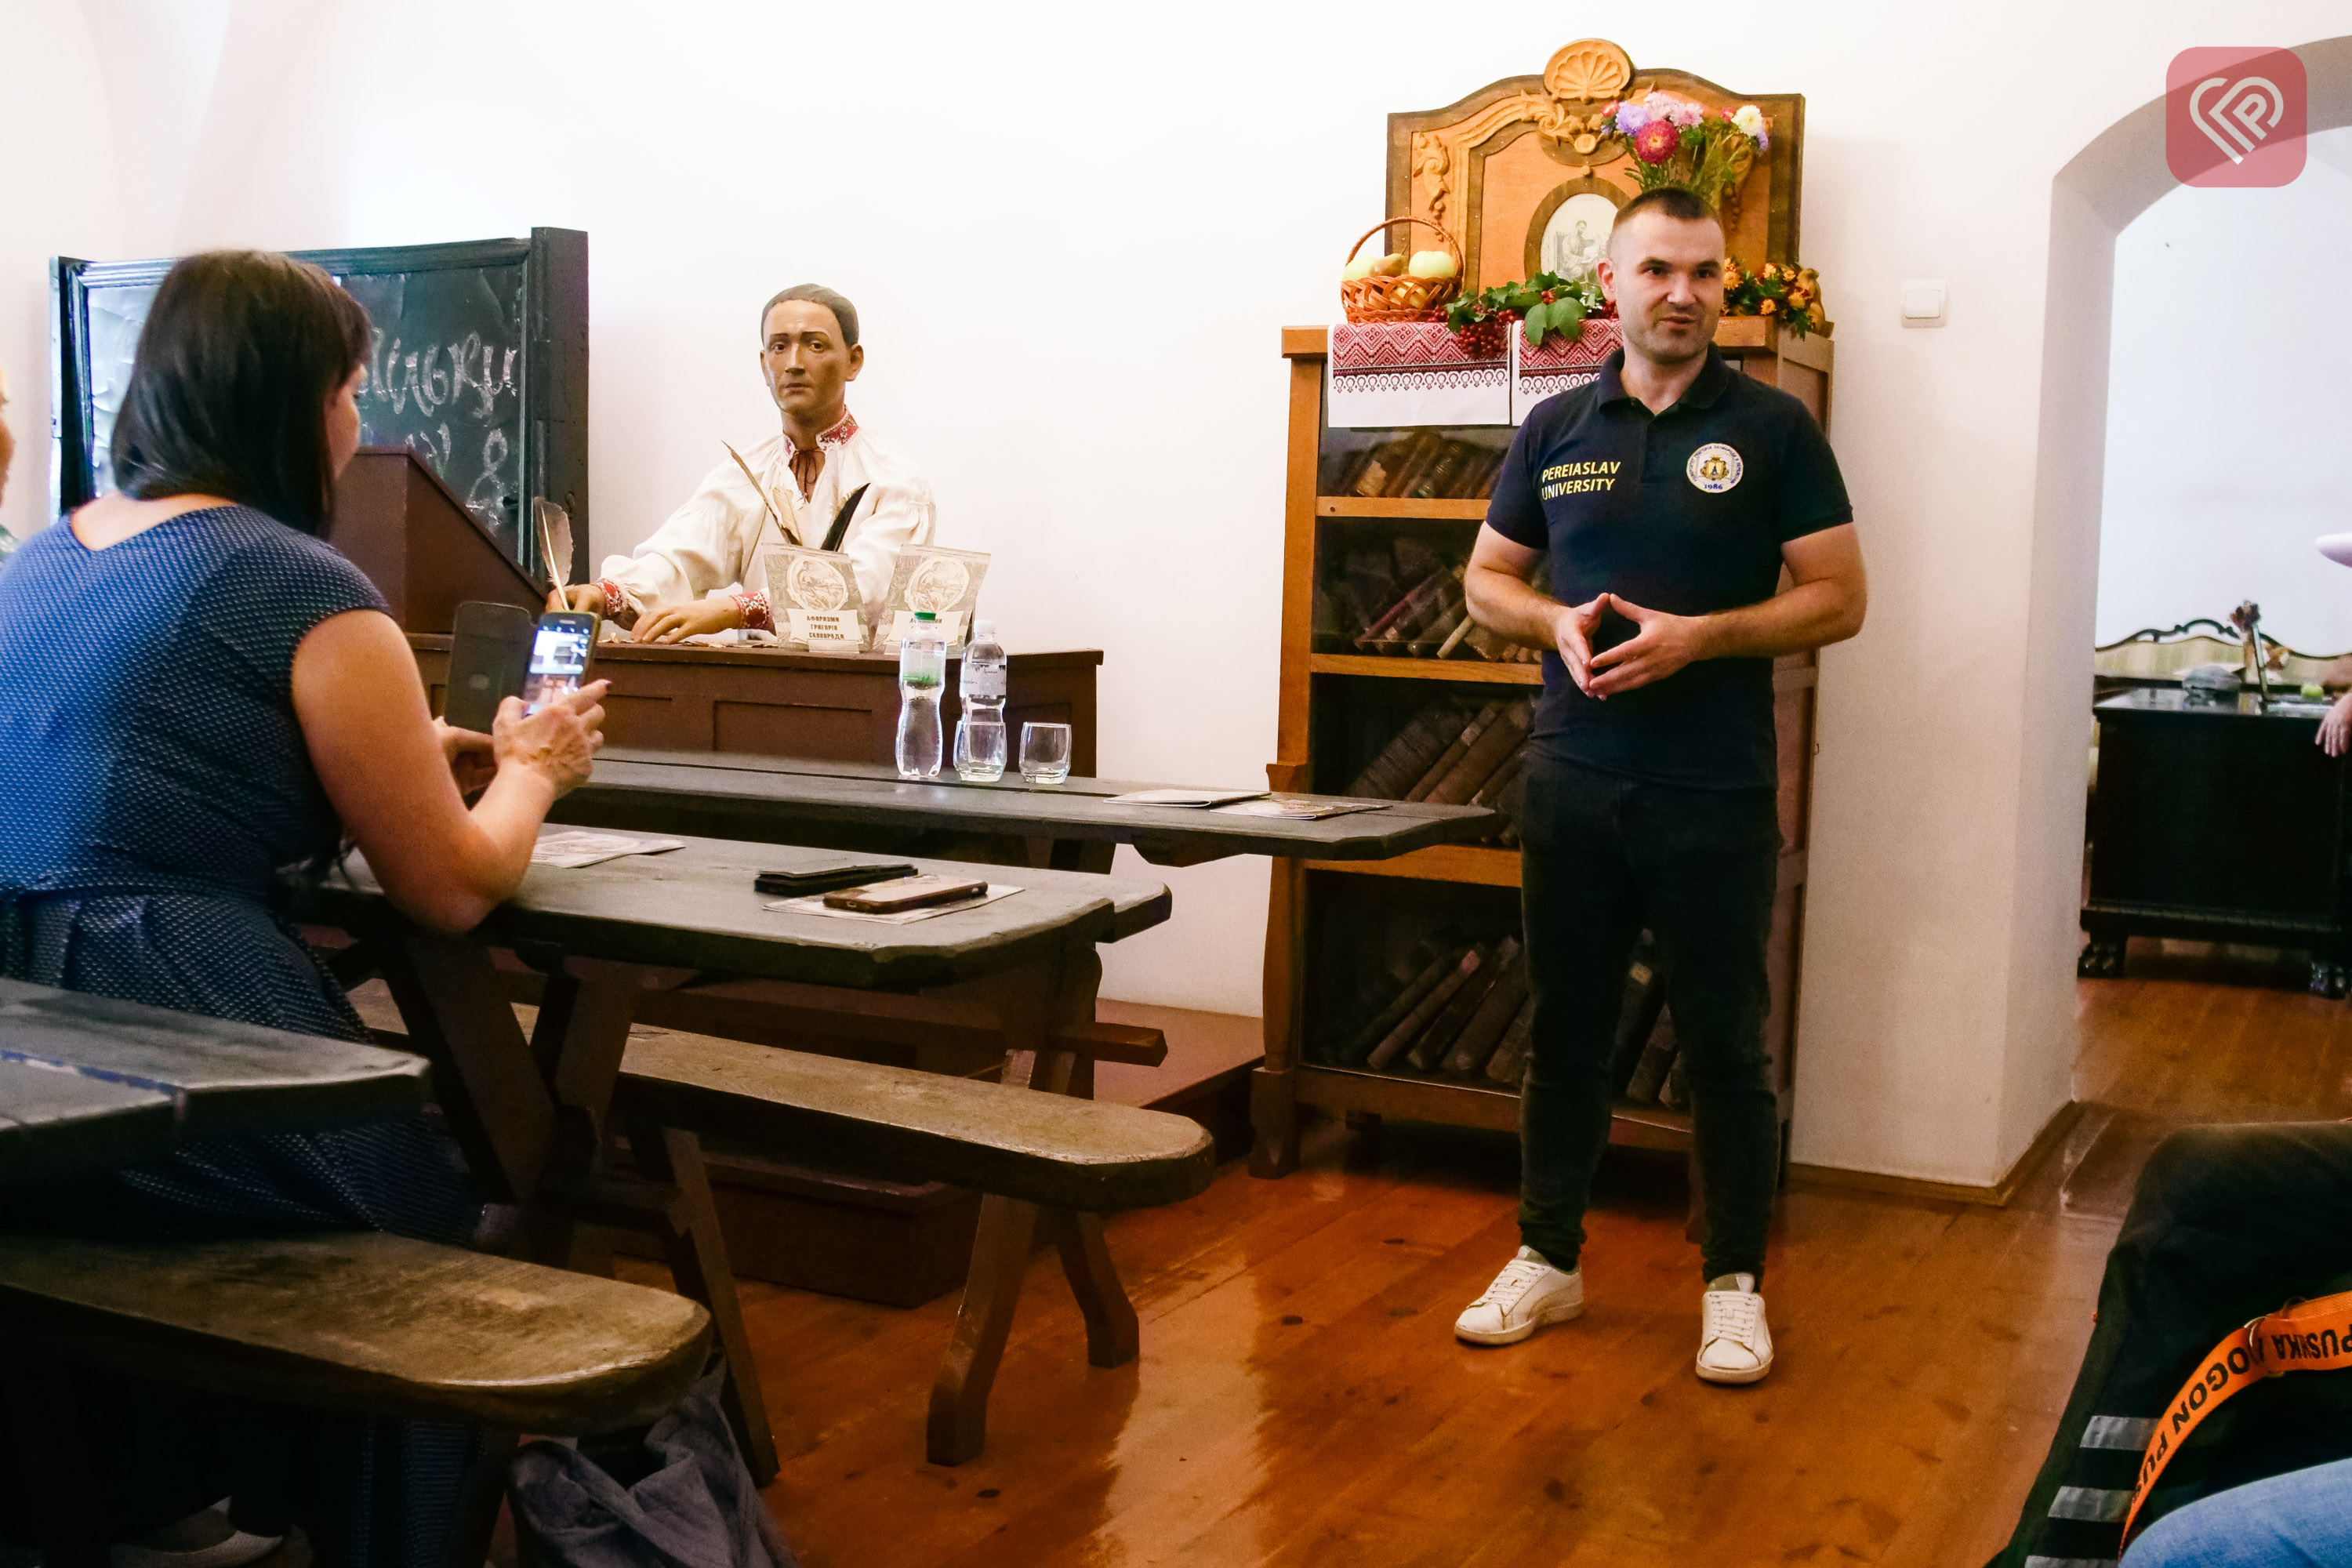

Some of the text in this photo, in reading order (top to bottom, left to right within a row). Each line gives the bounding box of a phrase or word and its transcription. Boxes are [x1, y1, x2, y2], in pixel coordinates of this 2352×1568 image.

[1542, 461, 1621, 483] PEREIASLAV
[1541, 478, 1615, 500] UNIVERSITY
[808, 632, 845, 641] СКОВОРОДИ
